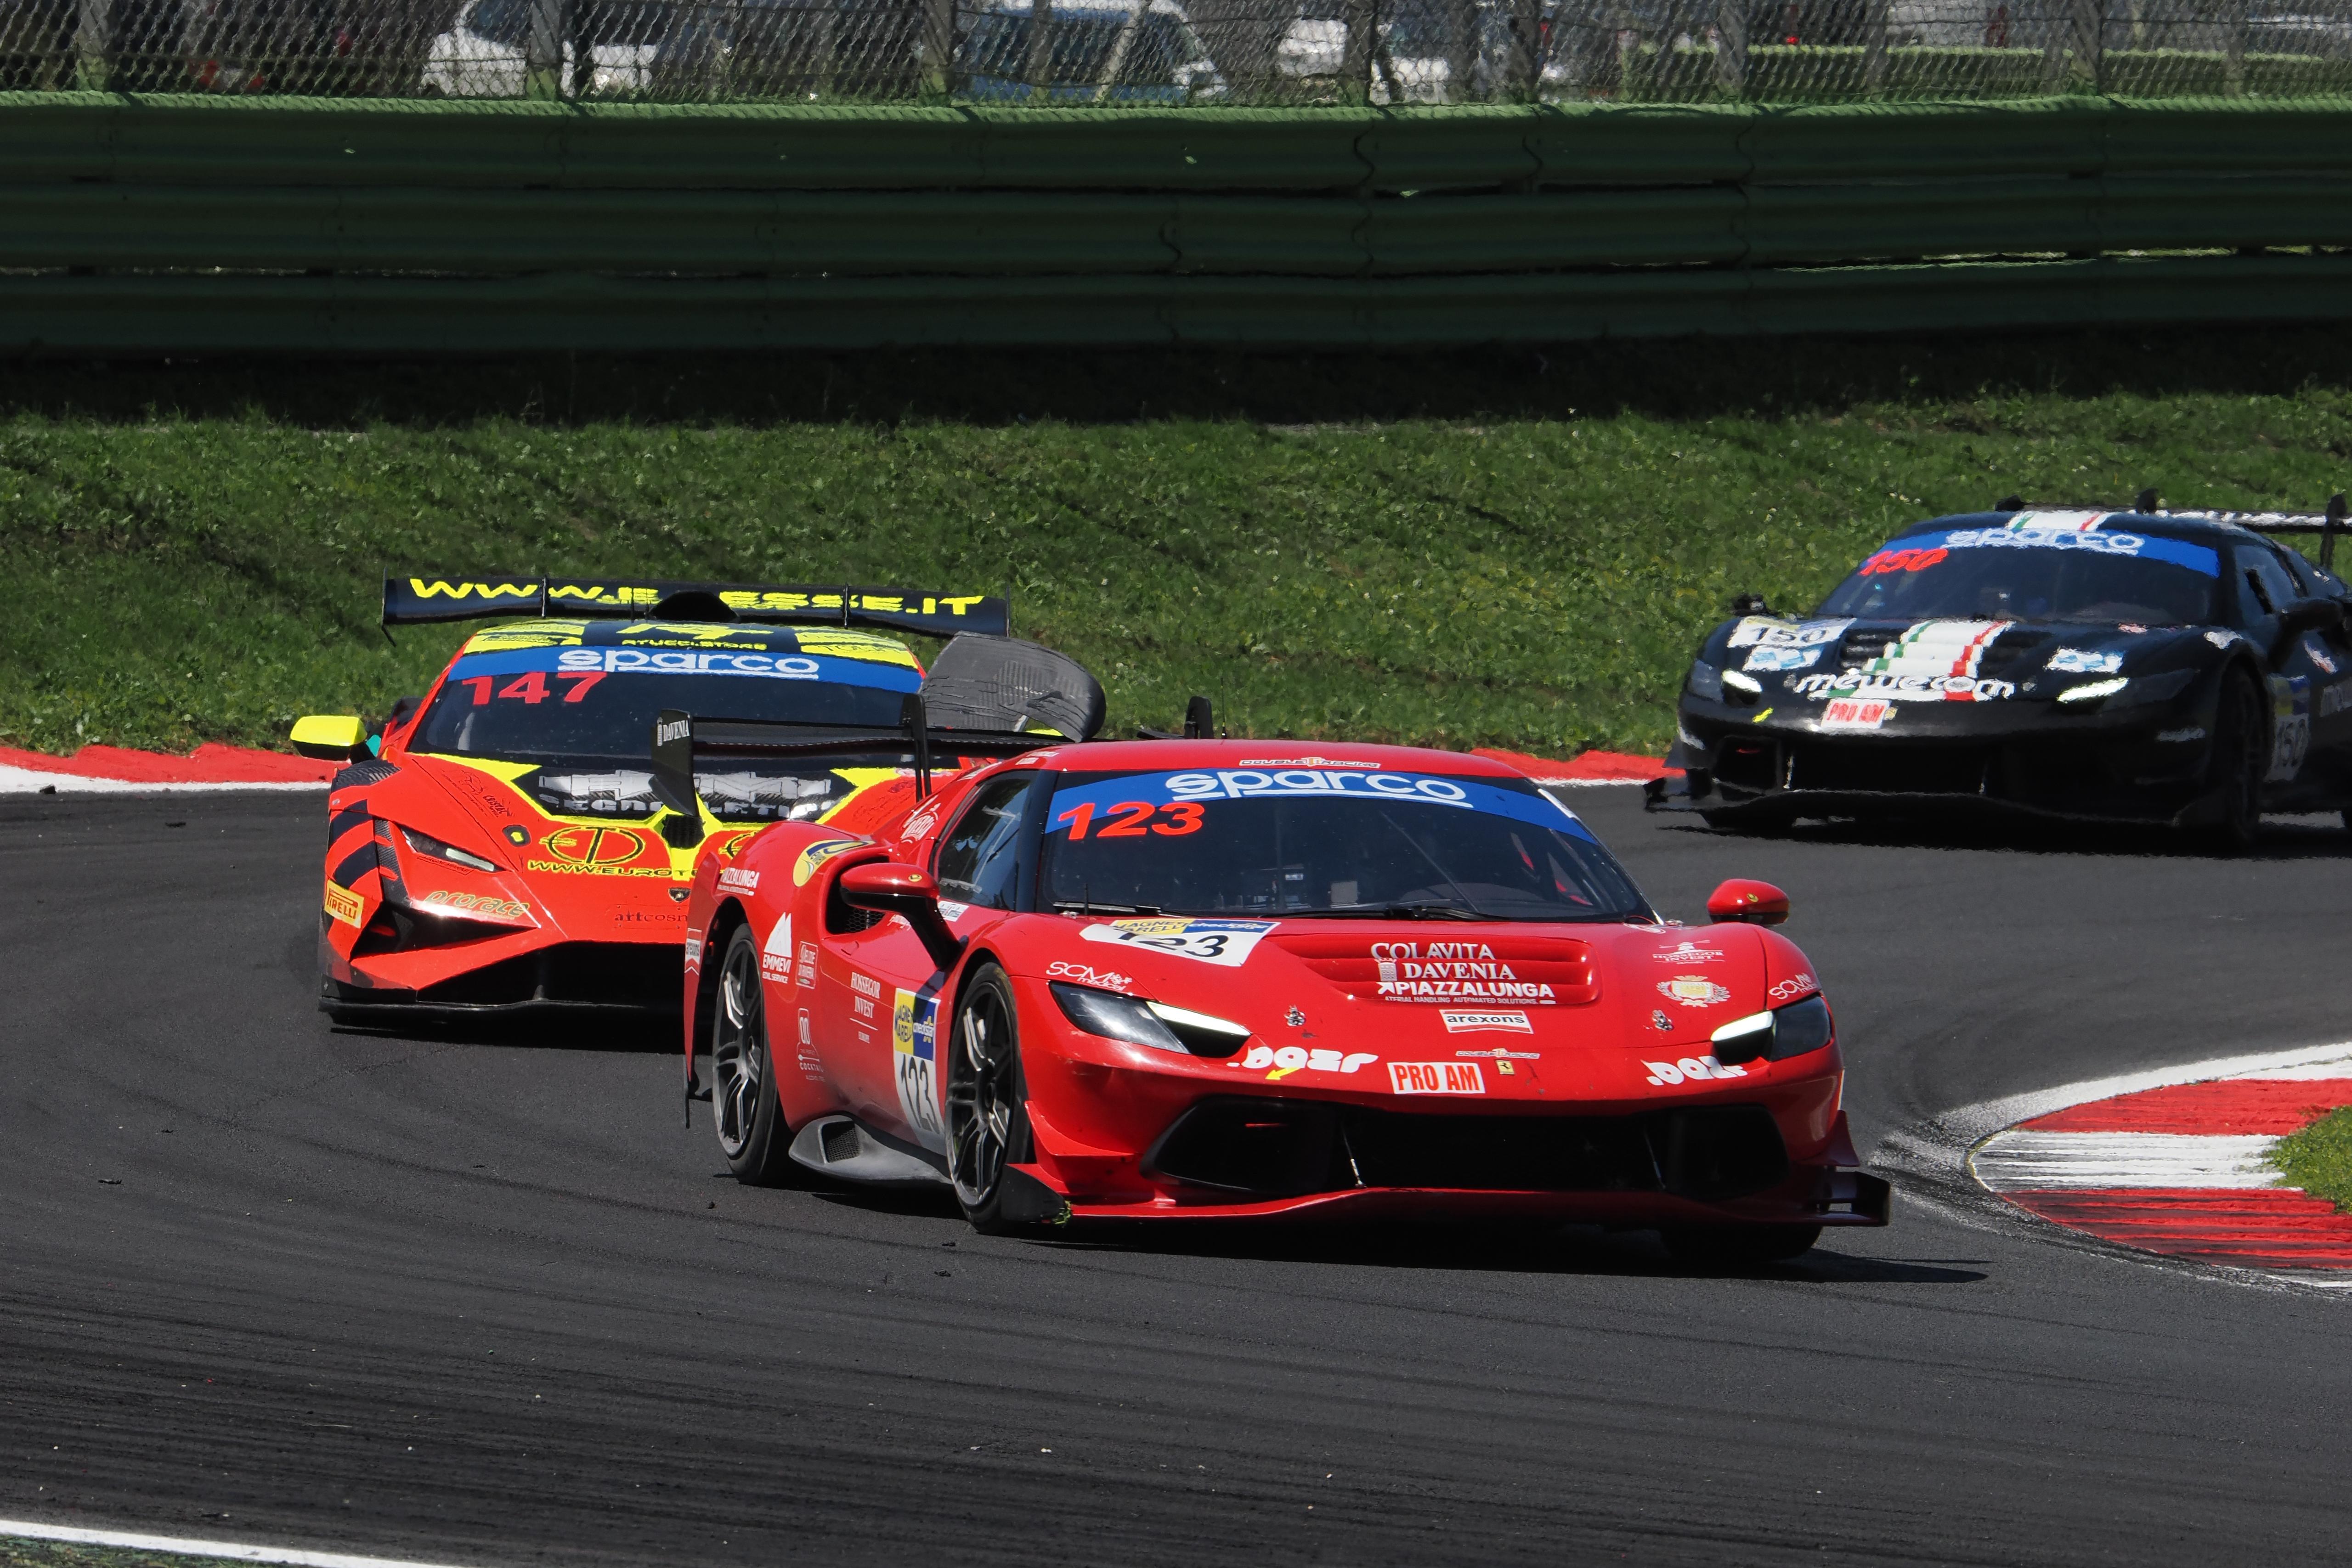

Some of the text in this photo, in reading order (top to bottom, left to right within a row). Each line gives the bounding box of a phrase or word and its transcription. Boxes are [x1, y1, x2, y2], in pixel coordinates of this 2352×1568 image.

[1944, 528, 2144, 554] sparco
[1859, 548, 1949, 576] 150
[1750, 626, 1828, 643] 150
[558, 649, 819, 675] sparco
[462, 671, 607, 705] 147
[1827, 701, 1859, 722] PRO
[1165, 771, 1470, 804] sparco
[1058, 802, 1204, 840] 123
[529, 860, 698, 876] WWW.EUROT
[327, 887, 358, 919] PIRELLI
[424, 891, 529, 917] prorace
[1114, 928, 1228, 957] 123
[1371, 943, 1497, 959] COLAVITA
[762, 953, 792, 974] EMMEVI
[1046, 961, 1115, 983] SCM
[1402, 963, 1516, 980] DAVENIA
[850, 971, 881, 999] HOSSEGOR
[1077, 977, 1126, 991] medical
[1395, 981, 1555, 997] PIAZZALUNGA
[854, 995, 875, 1019] INVEST
[1447, 1014, 1525, 1024] arexons
[1395, 1065, 1481, 1091] PRO AM
[901, 1054, 941, 1135] 123
